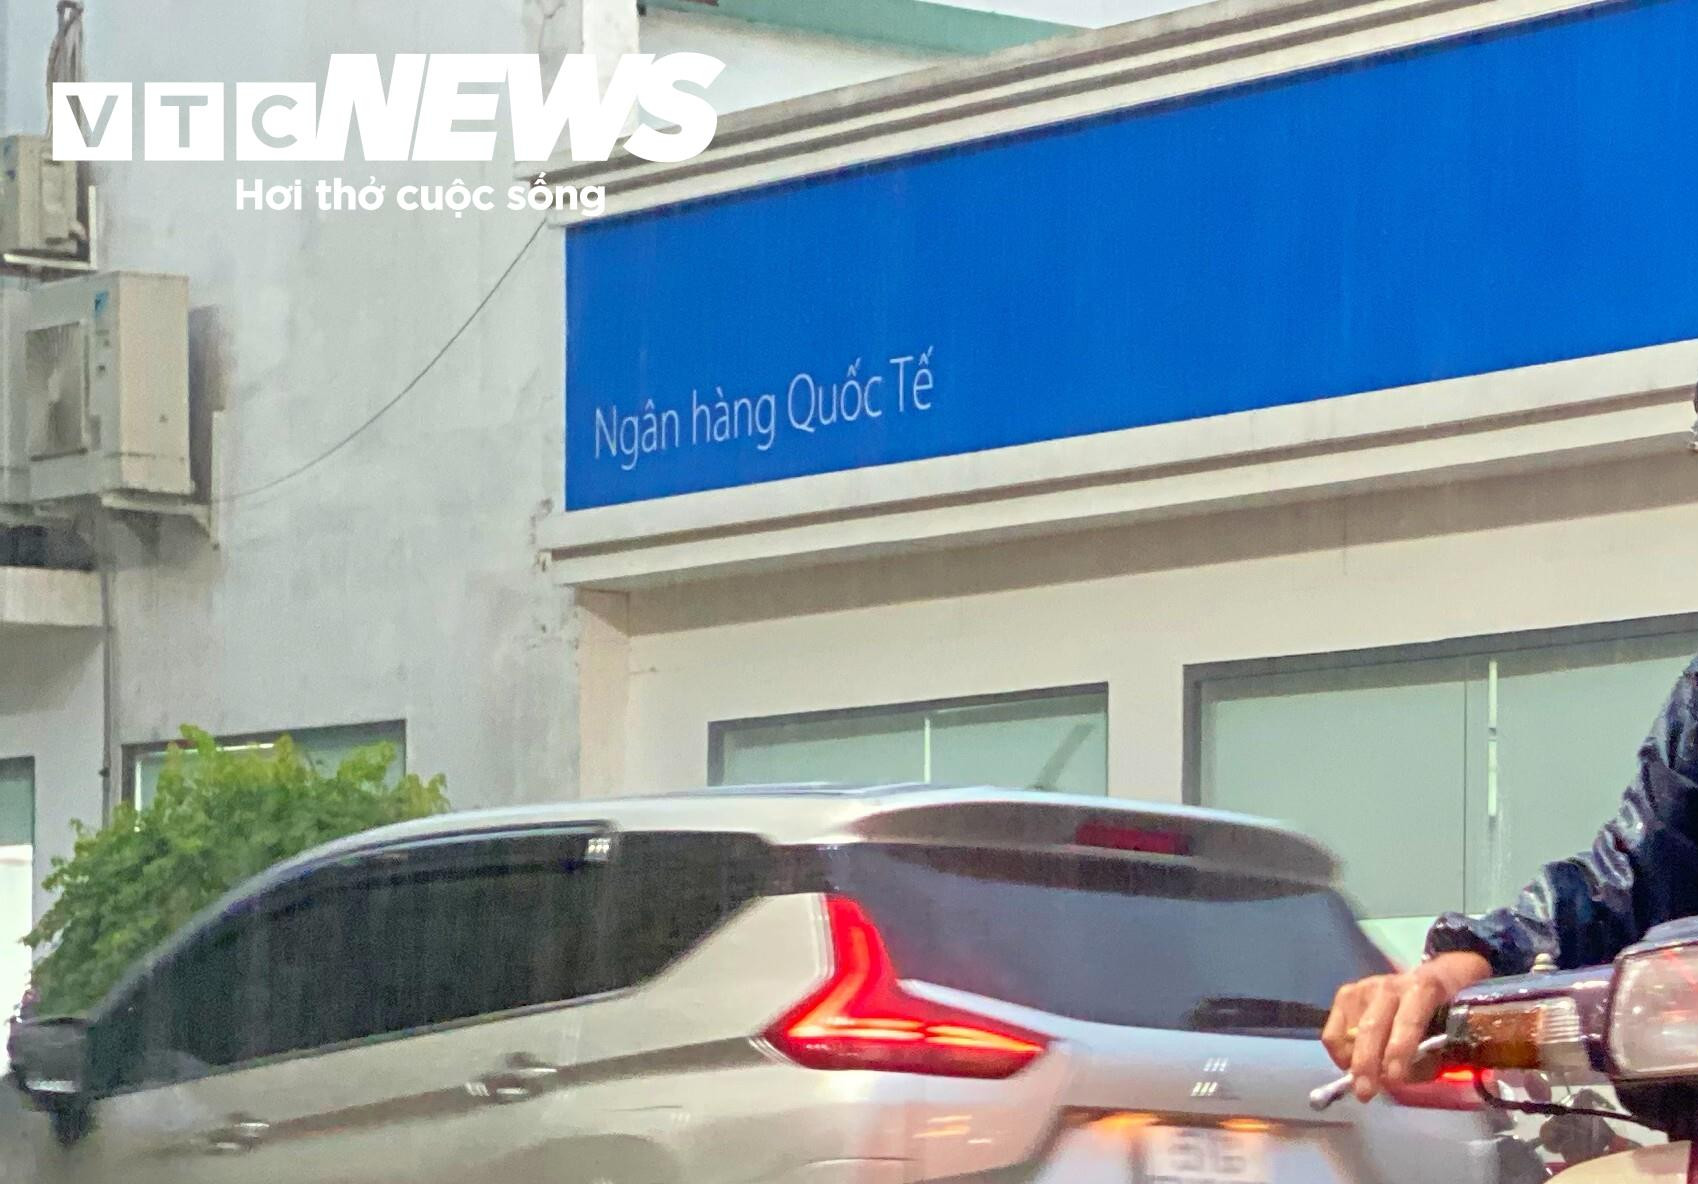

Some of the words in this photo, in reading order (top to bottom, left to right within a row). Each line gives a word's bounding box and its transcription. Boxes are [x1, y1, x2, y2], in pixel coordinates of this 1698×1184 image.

[595, 398, 680, 471] Ngân
[692, 386, 777, 451] hàng
[788, 357, 883, 433] Quốc
[890, 345, 934, 412] Tế
